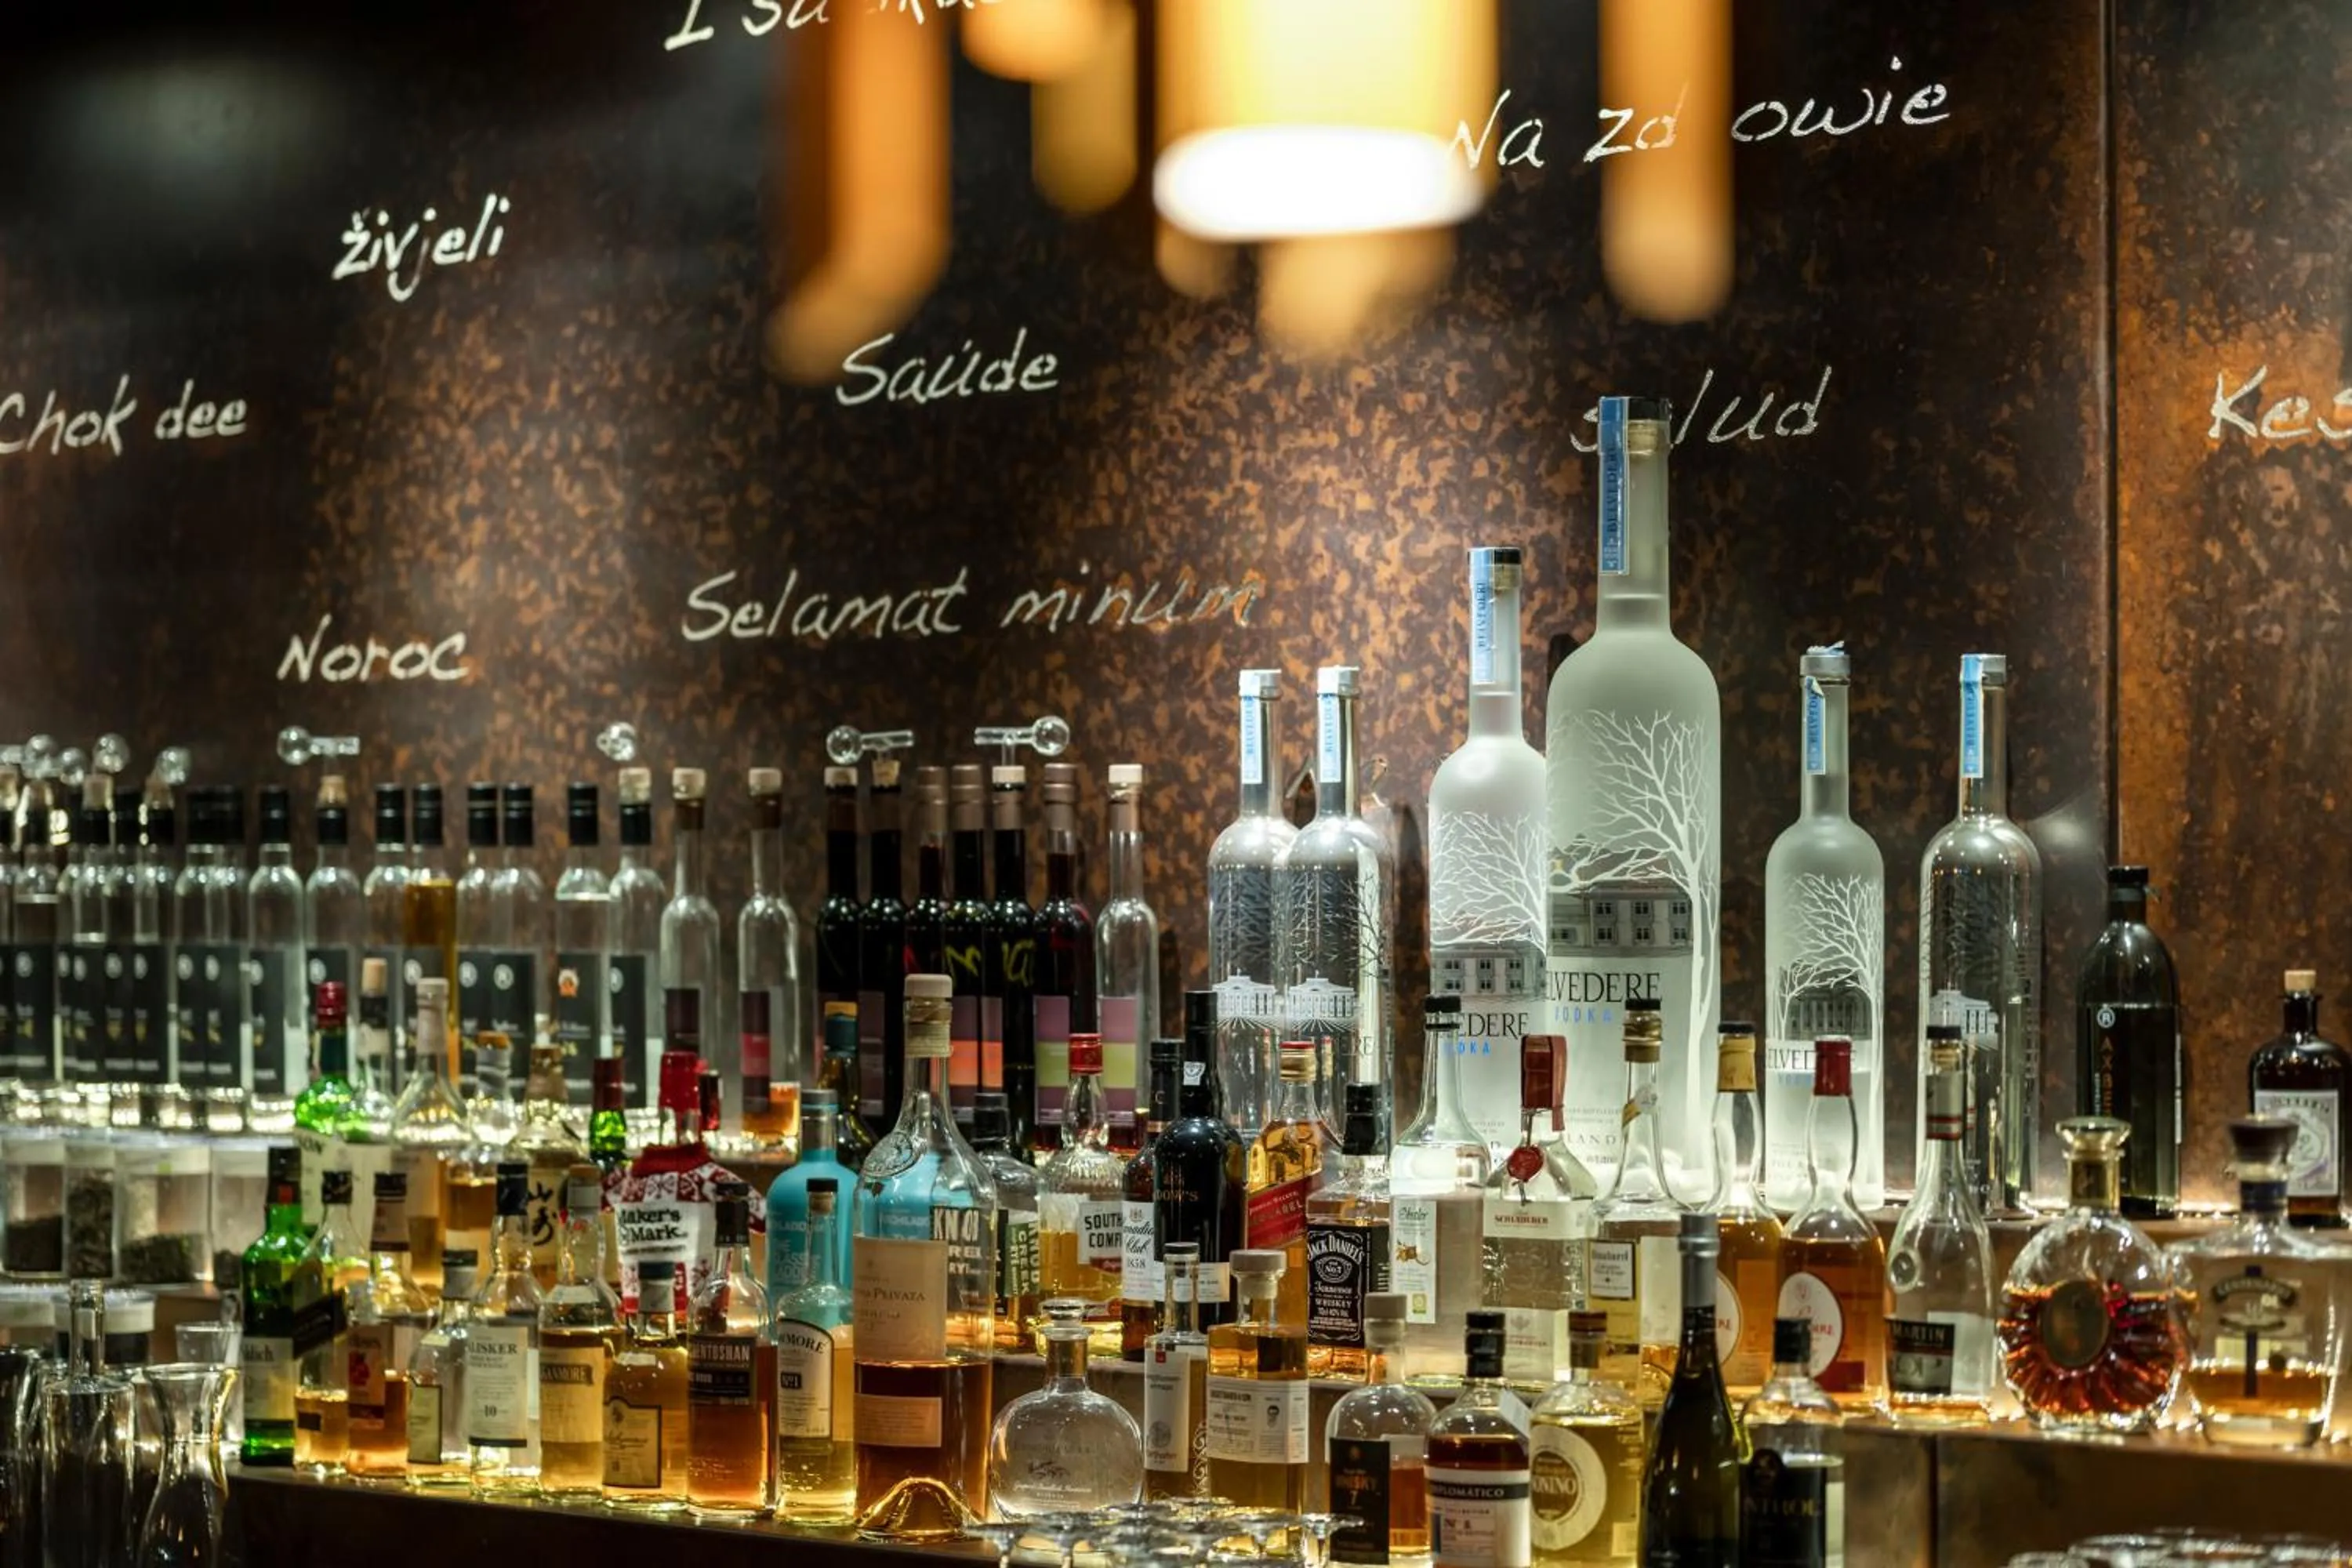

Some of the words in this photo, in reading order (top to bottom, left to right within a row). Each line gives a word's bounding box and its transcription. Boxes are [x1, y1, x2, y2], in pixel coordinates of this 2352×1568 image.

[1448, 89, 1544, 170] Na
[0, 374, 137, 456] Chok
[155, 379, 248, 441] dee
[1570, 364, 1833, 453] slud
[682, 566, 967, 641] Selamat
[1004, 561, 1262, 632] minum
[276, 615, 472, 684] Noroc
